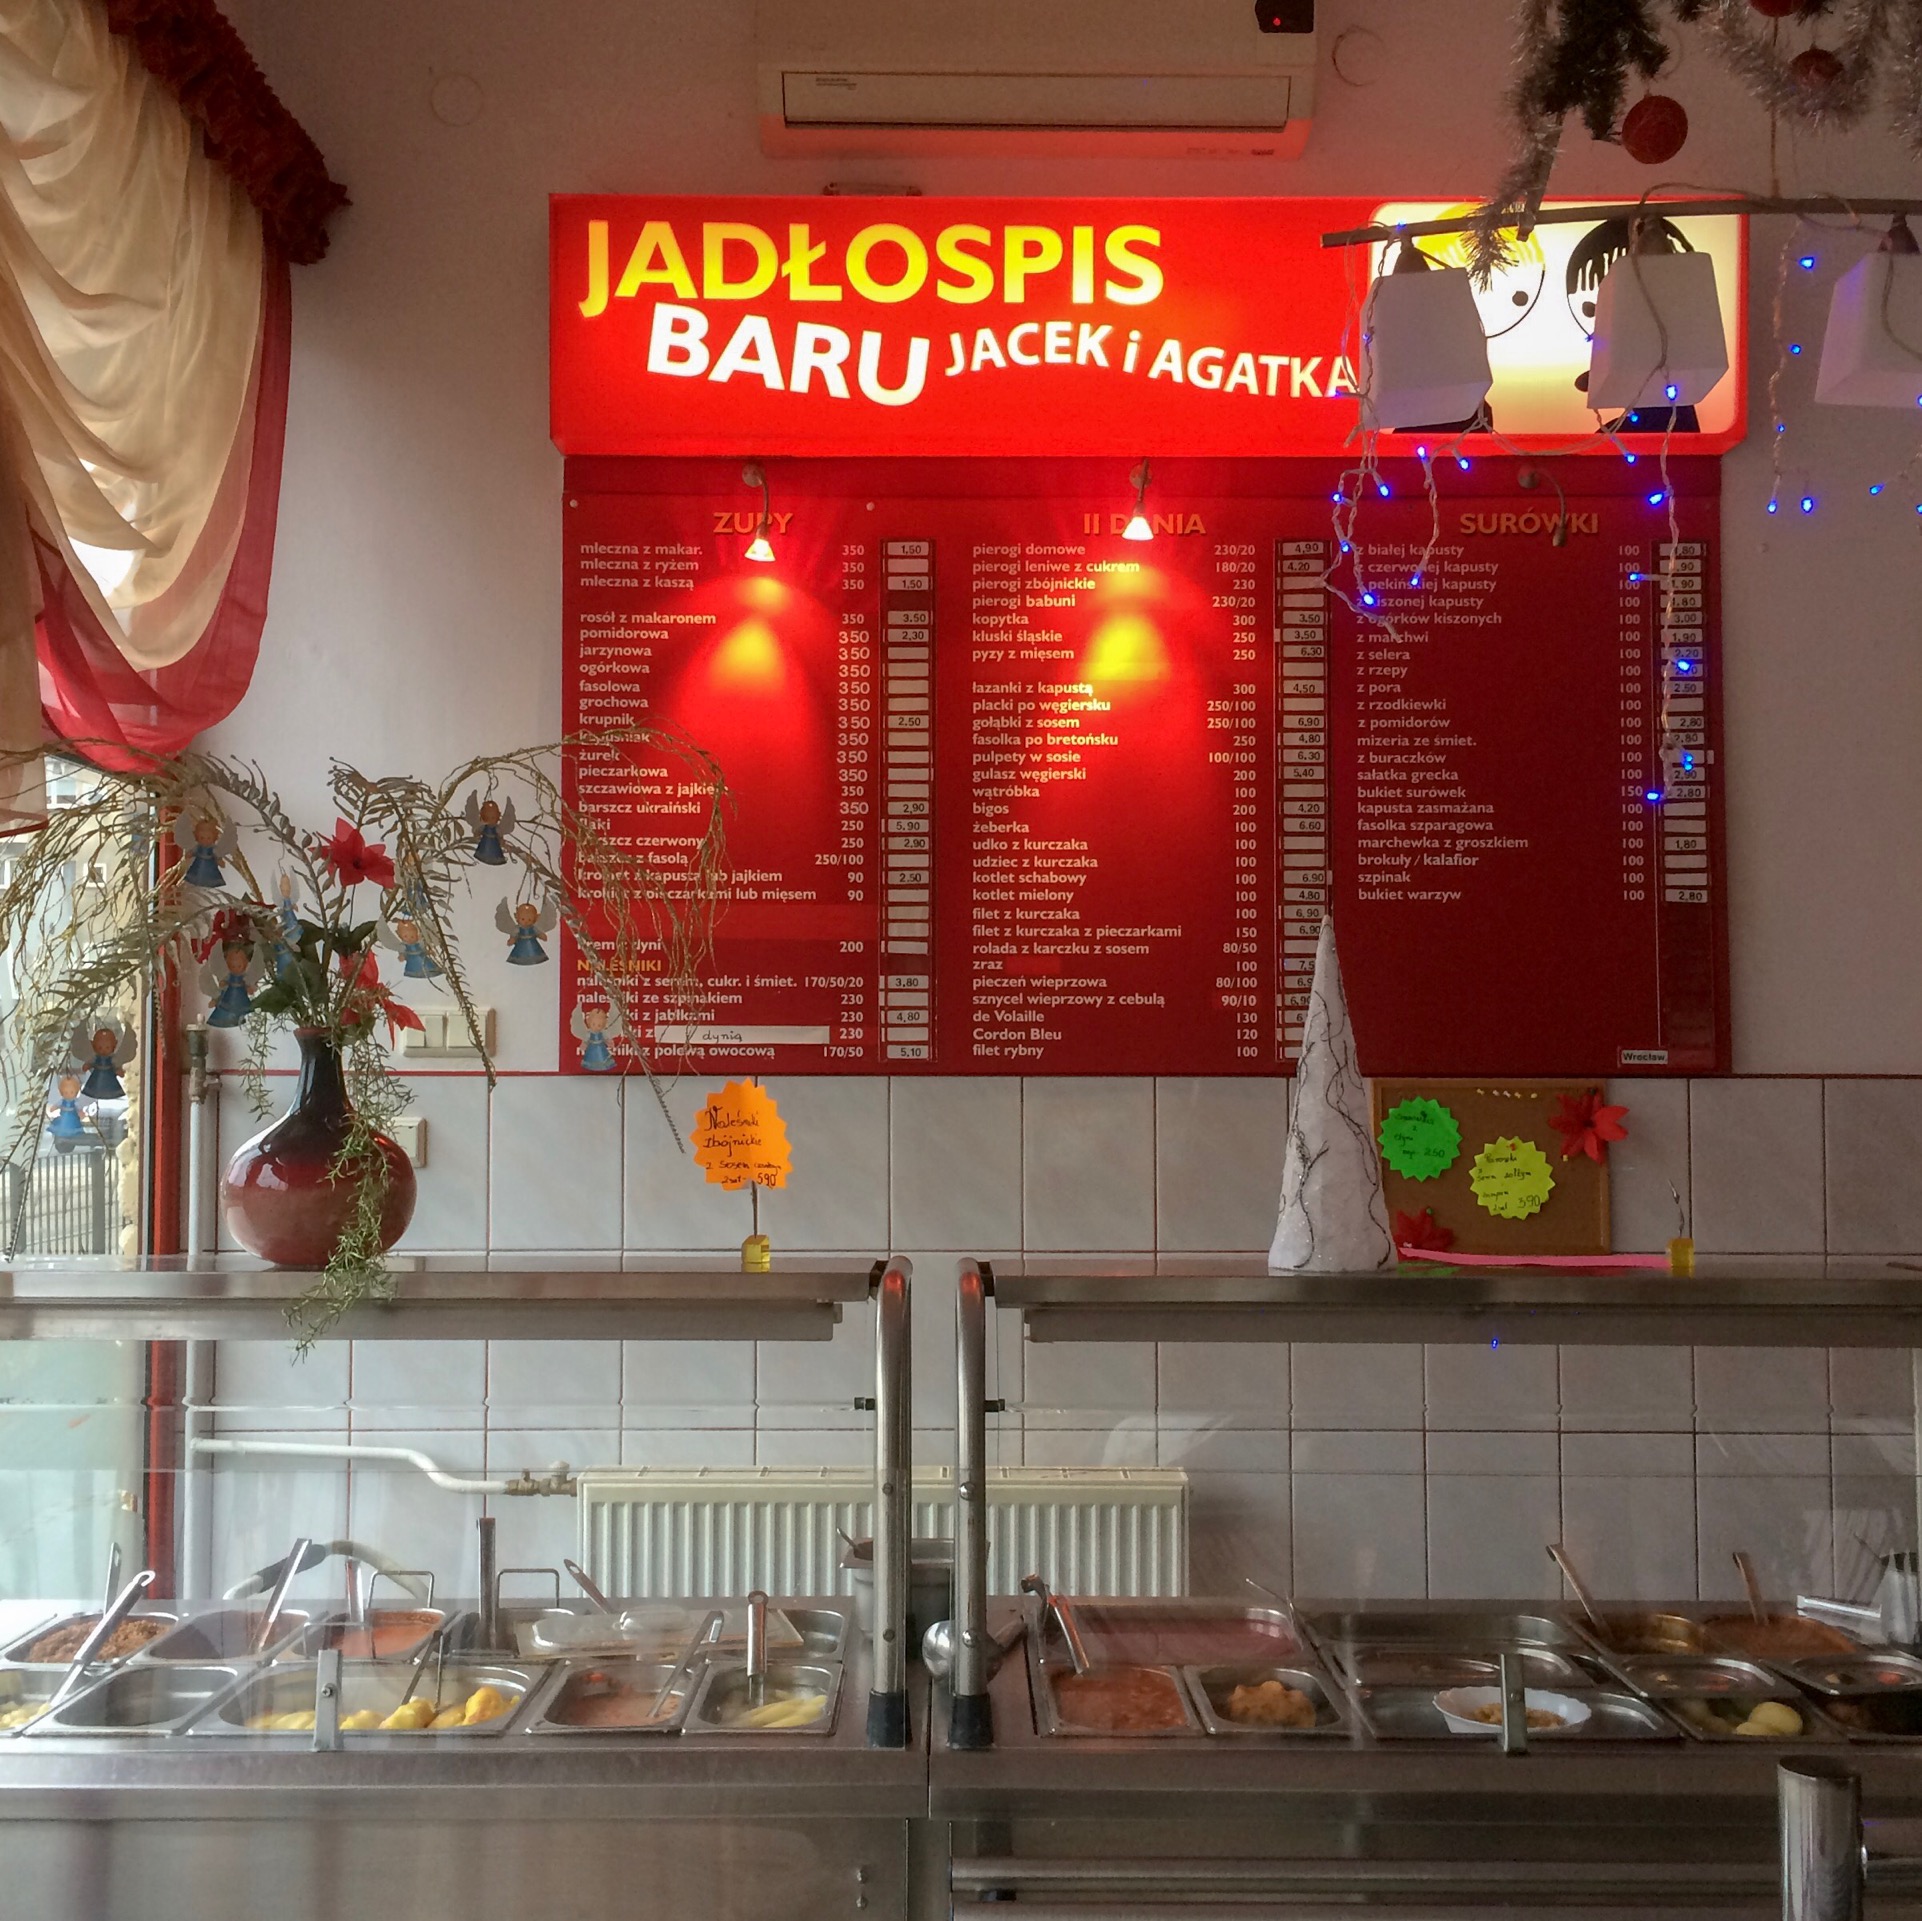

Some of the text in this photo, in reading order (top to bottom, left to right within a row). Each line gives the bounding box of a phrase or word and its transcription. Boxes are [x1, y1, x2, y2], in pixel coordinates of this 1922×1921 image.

[578, 219, 1164, 318] JADŁOSPIS
[646, 302, 1359, 406] BARU JACEK i AGATKA
[1083, 513, 1207, 535] II DNIA
[1459, 506, 1599, 534] SURÓWKI
[580, 541, 703, 556] mleczna z makar.
[972, 542, 1086, 559] pierogi domowe
[1214, 544, 1256, 557] 230/20
[1368, 543, 1405, 558] białej
[1216, 561, 1256, 574] 180/20
[1443, 561, 1499, 575] kapusty
[580, 574, 639, 588] mleczna
[642, 578, 652, 588] z
[841, 578, 865, 590] 350
[972, 593, 1076, 610] pierogi babuni
[619, 614, 628, 624] z
[631, 611, 717, 625] makaronem
[972, 612, 1030, 628] kopytka
[1433, 611, 1502, 627] kiszonych
[579, 626, 670, 642] pomidorowa
[838, 630, 870, 645] 350
[972, 629, 1013, 642] kluski
[1232, 631, 1256, 644] 250
[579, 643, 653, 660] jarzynowa
[972, 649, 1005, 663] pyzy
[1007, 649, 1017, 659] z
[838, 664, 871, 678] 350
[578, 679, 641, 693] fasolowa
[1025, 684, 1034, 694] z
[578, 695, 649, 711] grochowa
[972, 698, 1014, 714] placki
[1017, 701, 1036, 714] po
[1206, 700, 1257, 713] 250/100
[579, 712, 637, 728] krupnik
[837, 715, 871, 730] 350
[1357, 719, 1366, 728] z
[972, 732, 1022, 746] fasolka
[1024, 736, 1043, 749] po
[1357, 734, 1410, 747] mizeria
[1413, 737, 1430, 747] ze
[972, 749, 1082, 766] pulpety w sosie
[1208, 751, 1257, 764] 100/100
[1357, 754, 1365, 764] z
[578, 764, 669, 779] pieczarkowa
[972, 767, 1017, 783] gulasz
[1233, 769, 1257, 781] 200
[1410, 768, 1459, 784] grecka
[579, 782, 728, 797] szczawiowa z jajkie
[1357, 785, 1403, 798] bukiet
[1621, 785, 1643, 797] 150
[579, 801, 632, 813] barszcz
[839, 801, 870, 815] 350
[972, 801, 1010, 818] bigos
[1357, 801, 1413, 817] kapusta
[840, 819, 864, 831] 250
[1356, 818, 1494, 835] fasolka szparagowa
[1357, 835, 1529, 852] marchewka z groszkiem
[814, 853, 864, 866] 250/100
[1423, 852, 1480, 866] kalafior
[731, 869, 783, 884] jajkiem
[972, 870, 1087, 887] kotlet schabowy
[1357, 870, 1411, 886] szpinak
[736, 887, 758, 899] lub
[972, 888, 1075, 904] kotlet mielony
[1358, 887, 1462, 904] bukiet warzyw
[1623, 889, 1645, 901] 100
[1236, 926, 1258, 938] 150
[839, 940, 864, 953] 200
[972, 960, 1004, 970] zraz
[707, 974, 742, 987] cukr.
[753, 974, 797, 987] śmiet.
[804, 976, 864, 989] 170/50/20
[1029, 975, 1108, 991] wieprzowa
[1215, 976, 1258, 989] 80/100
[972, 1009, 1045, 1023] de Volaille
[972, 1027, 1062, 1041] Cordon Bleu
[823, 1046, 864, 1059] 170/50
[972, 1043, 1045, 1060] filet rybny
